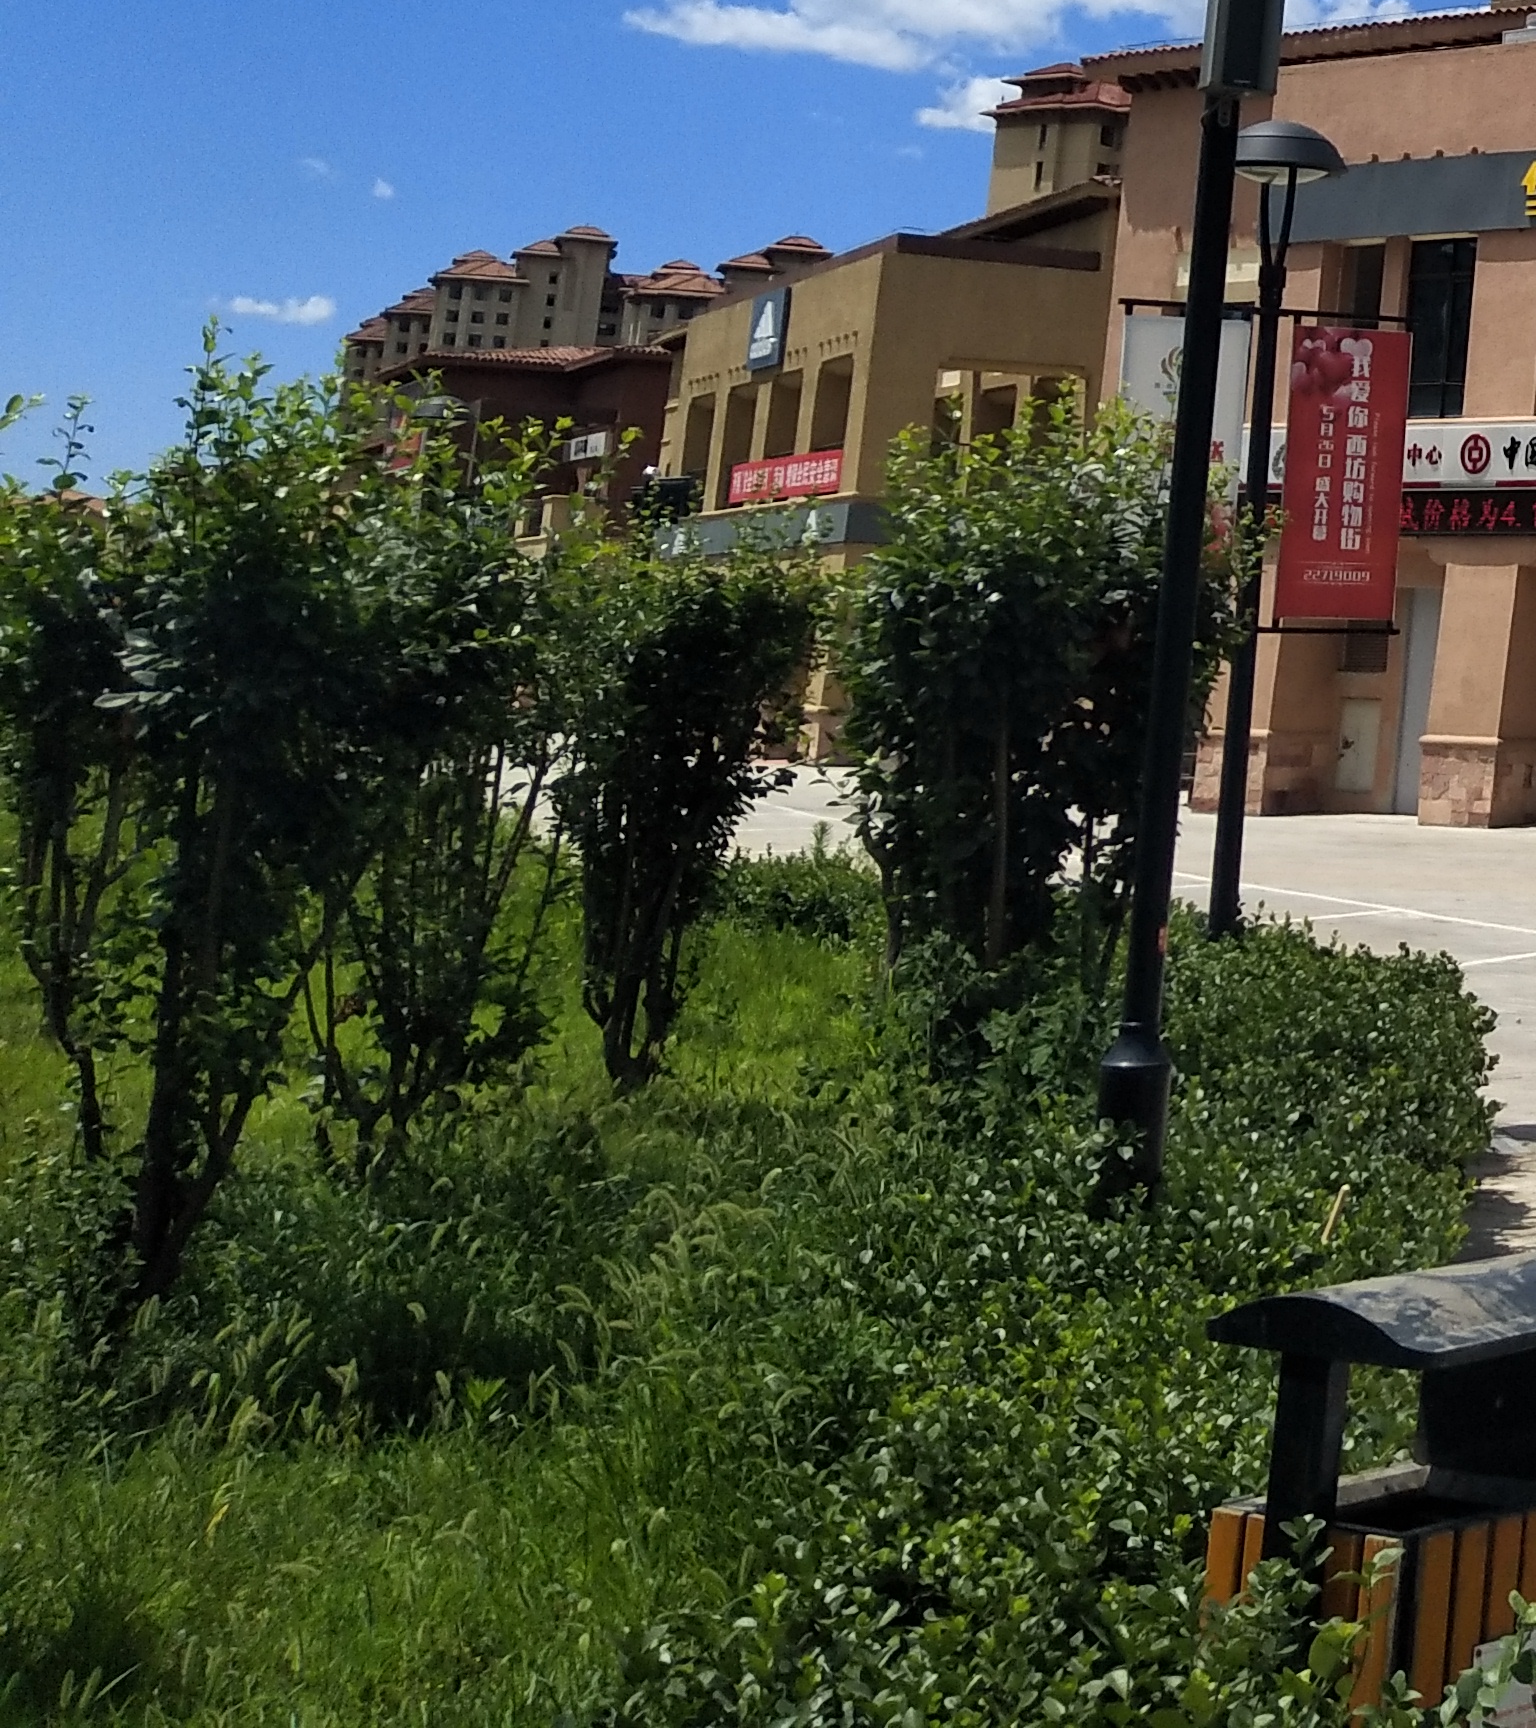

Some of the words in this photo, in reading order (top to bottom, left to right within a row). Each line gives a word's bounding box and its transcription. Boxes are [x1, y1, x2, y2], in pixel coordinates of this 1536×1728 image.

[1407, 443, 1442, 467] 中心
[1340, 434, 1367, 551] 西坊购物街
